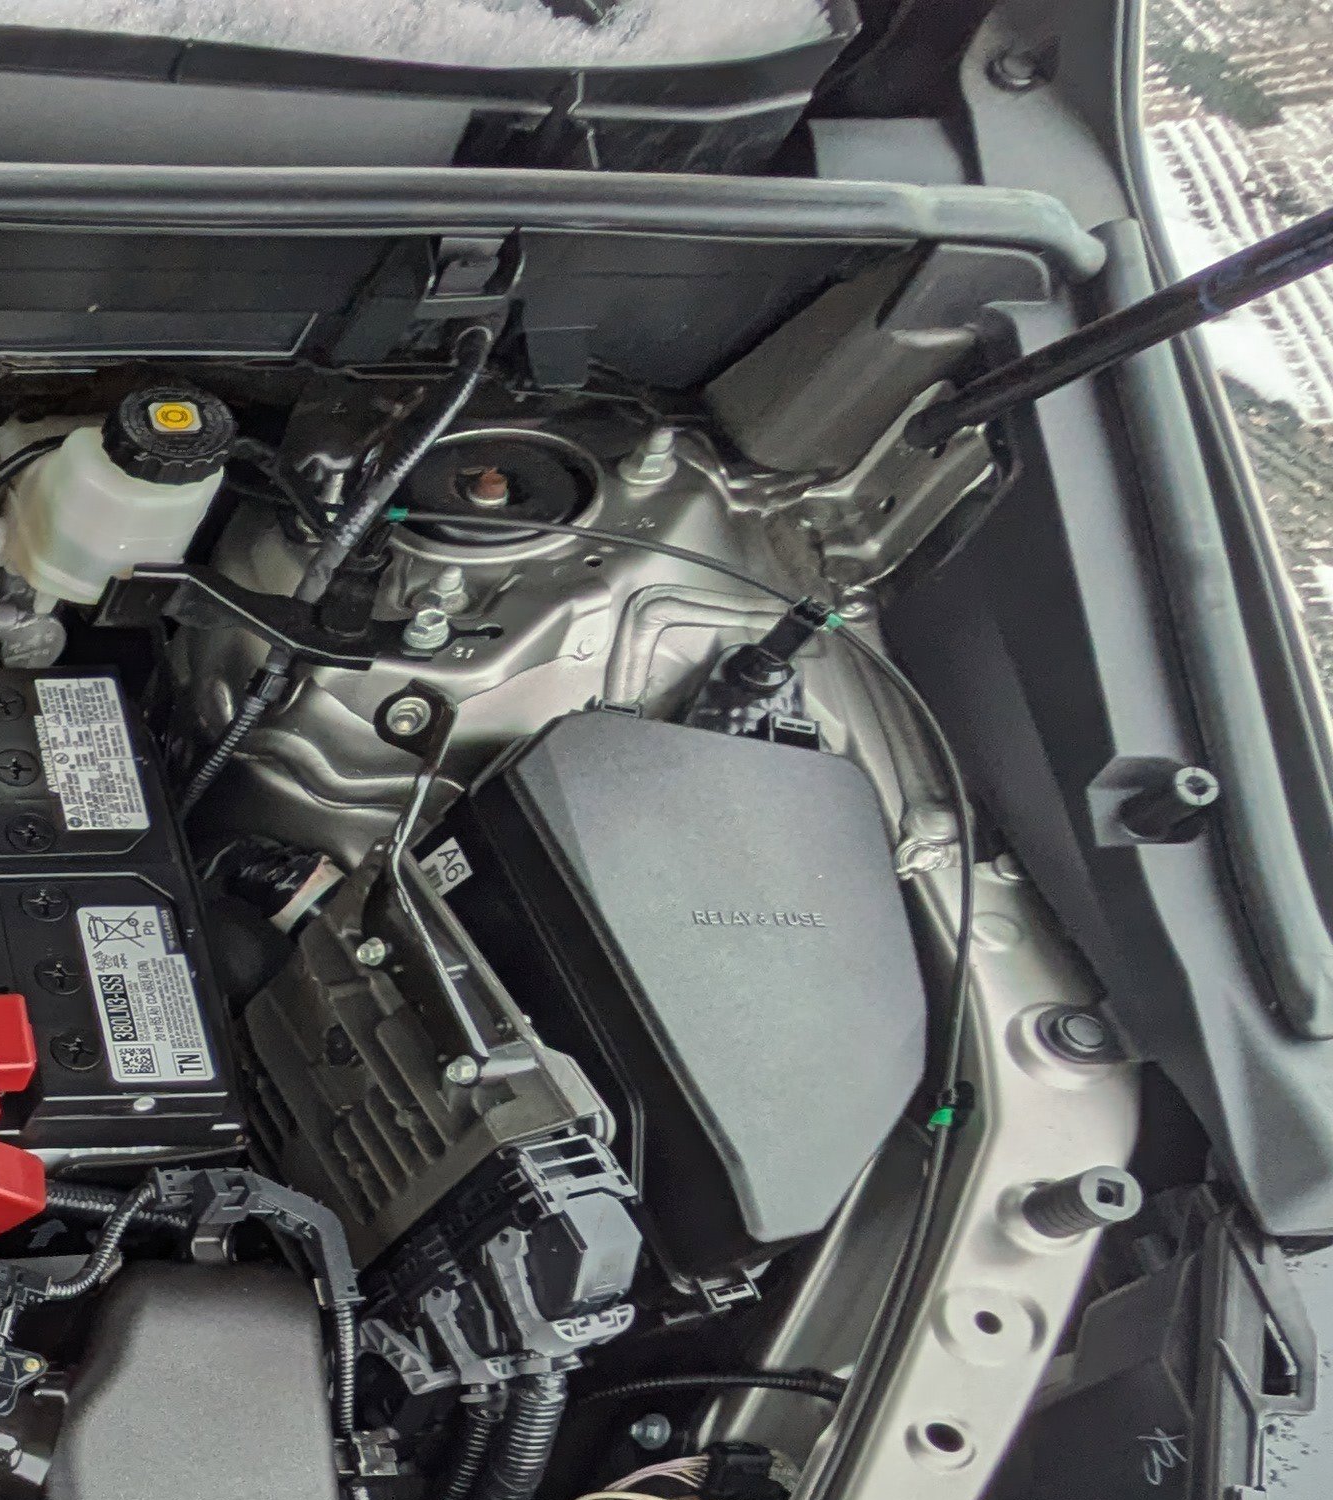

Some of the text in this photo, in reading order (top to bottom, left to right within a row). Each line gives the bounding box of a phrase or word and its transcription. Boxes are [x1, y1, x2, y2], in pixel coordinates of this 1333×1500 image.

[437, 845, 470, 883] A6
[143, 921, 156, 936] Pb
[692, 911, 750, 925] RELAY
[772, 912, 825, 927] FUSE
[101, 974, 137, 1040] 380LN3-ISS
[176, 1053, 204, 1074] TN
